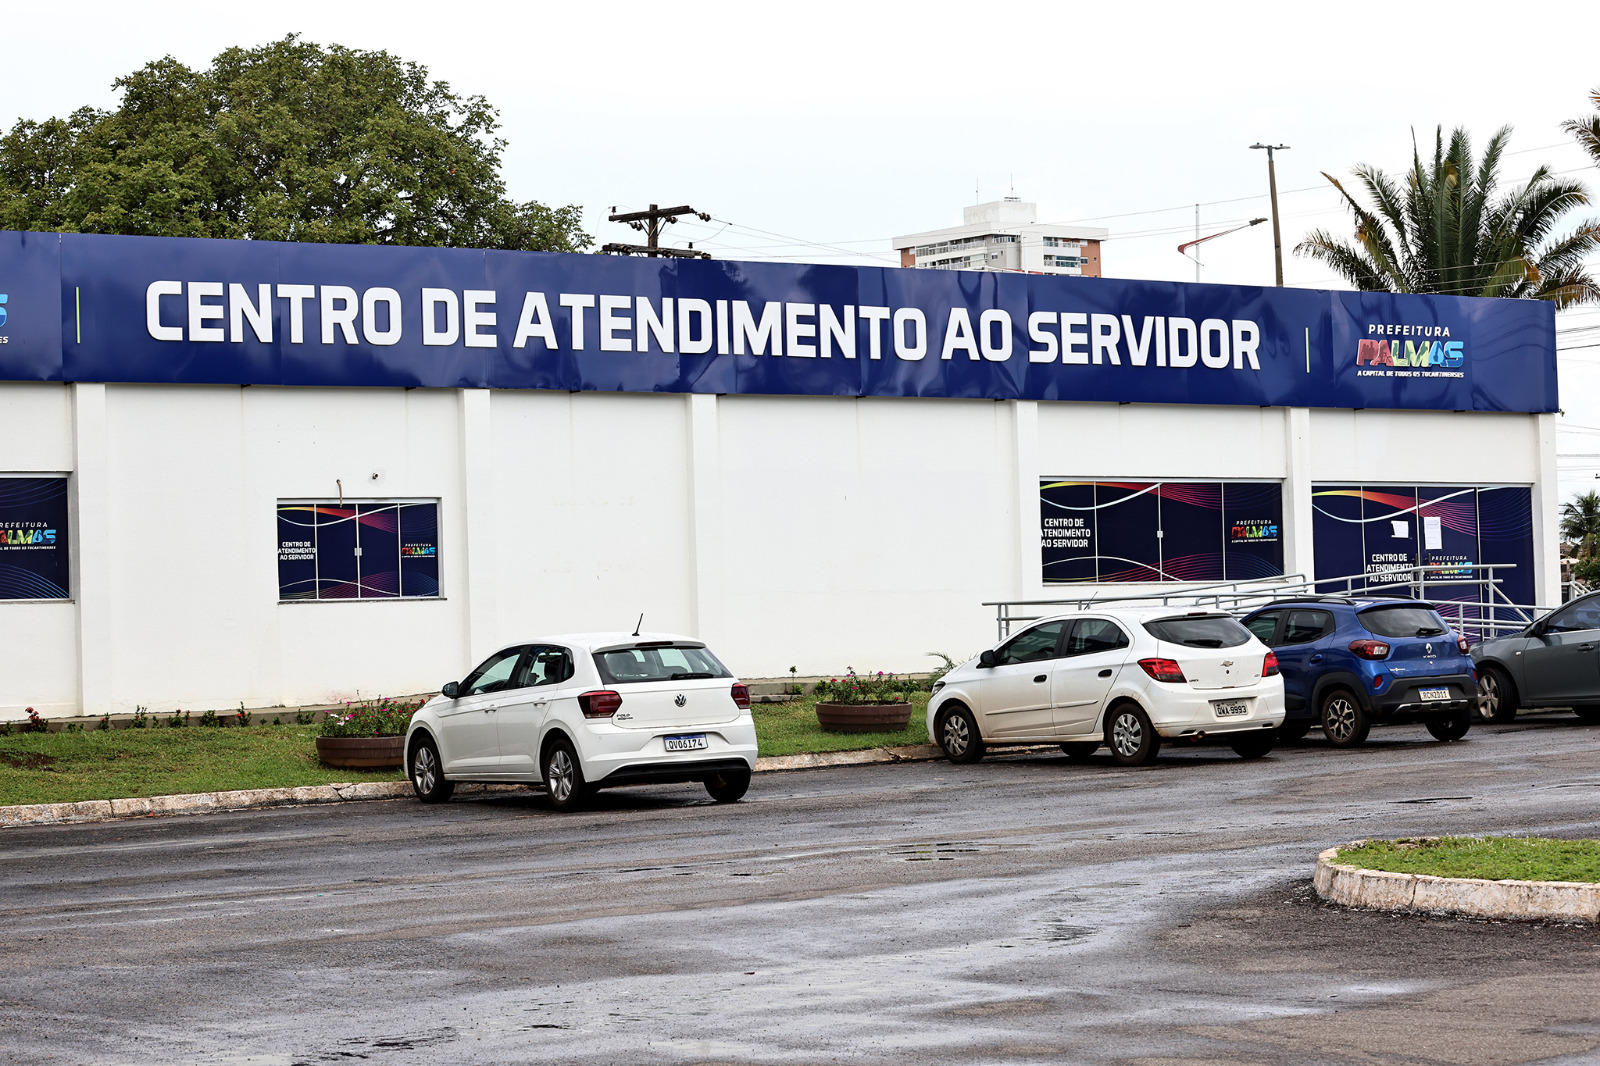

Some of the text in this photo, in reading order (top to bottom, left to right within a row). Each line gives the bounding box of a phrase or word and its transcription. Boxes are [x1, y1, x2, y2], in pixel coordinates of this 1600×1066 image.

[146, 280, 1261, 371] CENTRO DE ATENDIMENTO AO SERVIDOR
[1368, 324, 1451, 337] PREFEITURA
[1356, 339, 1464, 368] PALMAS
[1044, 518, 1085, 527] CENTRO DE
[0, 529, 57, 545] ALMAS
[1040, 528, 1091, 538] ATENDIMENTO
[1231, 525, 1278, 539] PALMAS
[1040, 539, 1089, 548] AO SERVIDOR
[1371, 553, 1408, 562] CENTRO DE
[1366, 563, 1414, 573] ATENDIMENTO
[1369, 573, 1413, 582] AO SERVIDOR
